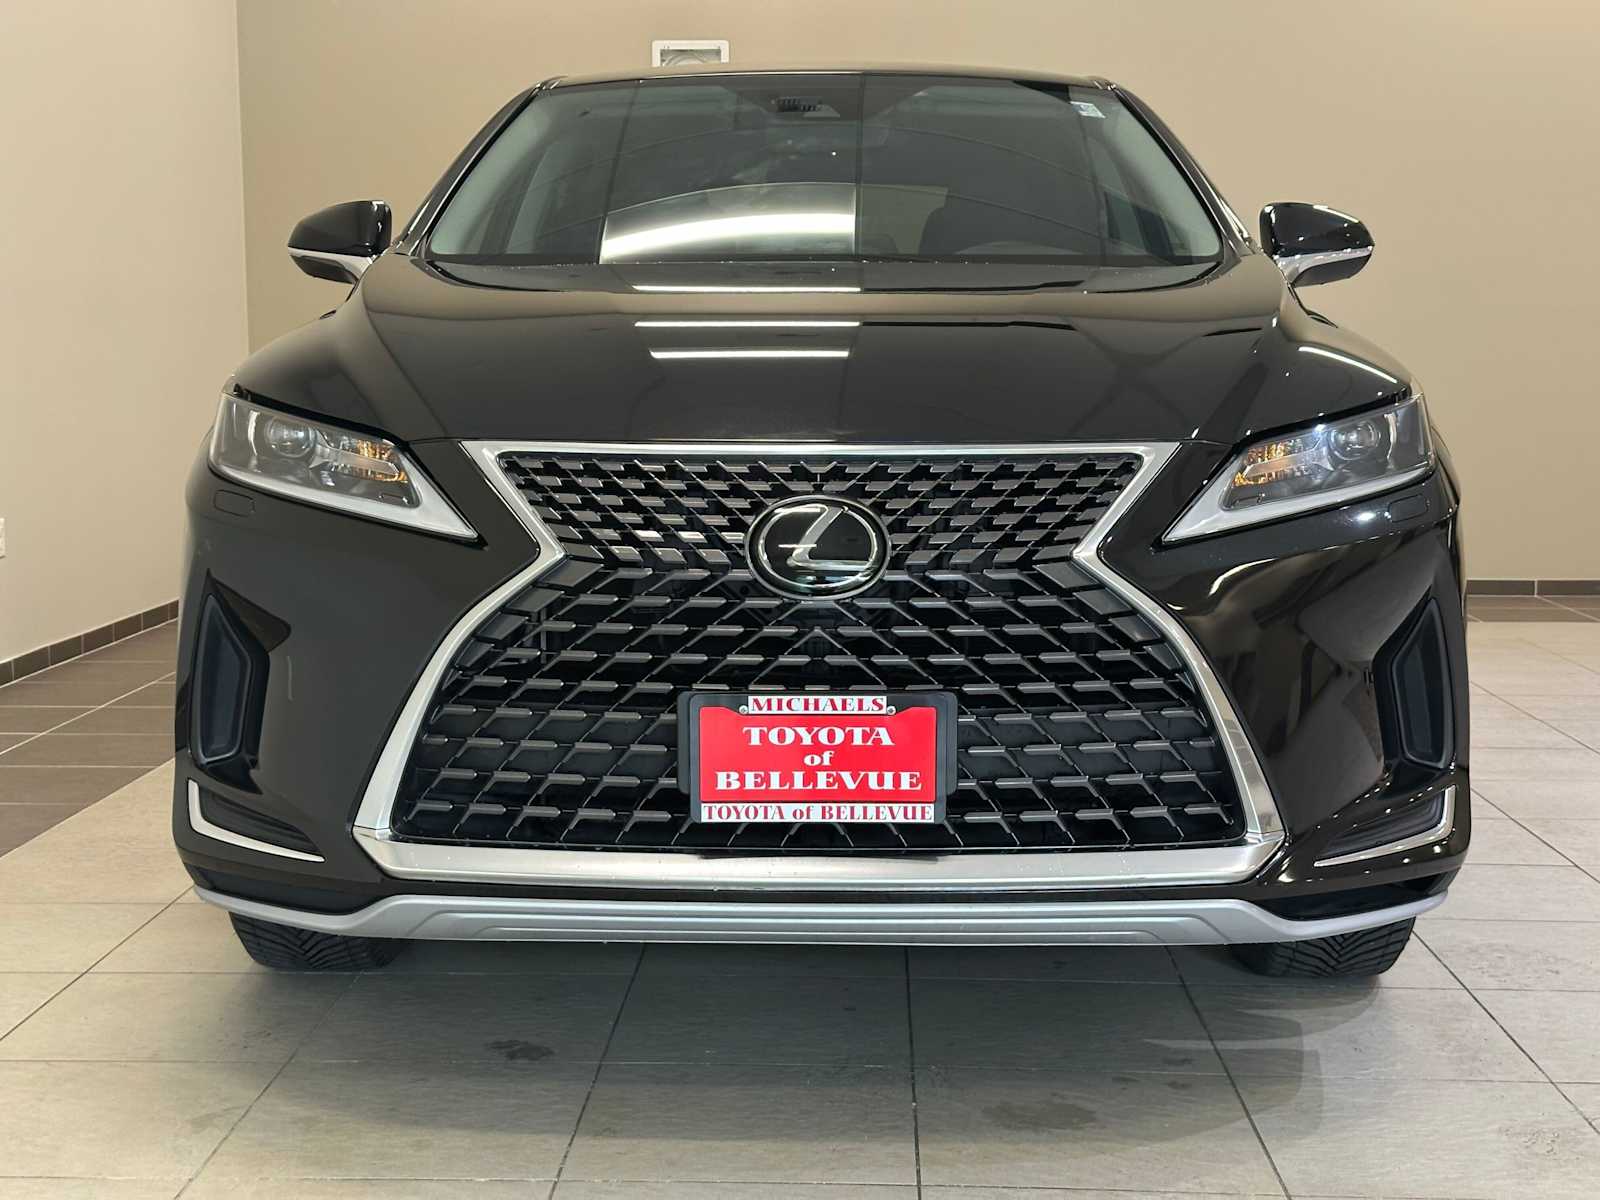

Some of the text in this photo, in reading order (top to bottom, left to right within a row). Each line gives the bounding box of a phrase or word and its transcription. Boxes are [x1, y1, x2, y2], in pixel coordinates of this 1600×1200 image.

[752, 697, 884, 712] MICHAELS
[743, 727, 895, 746] TOYOTA
[803, 751, 834, 766] of
[715, 771, 922, 790] BELLEVUE
[704, 805, 932, 820] TOYOTA of BELLEVUE
